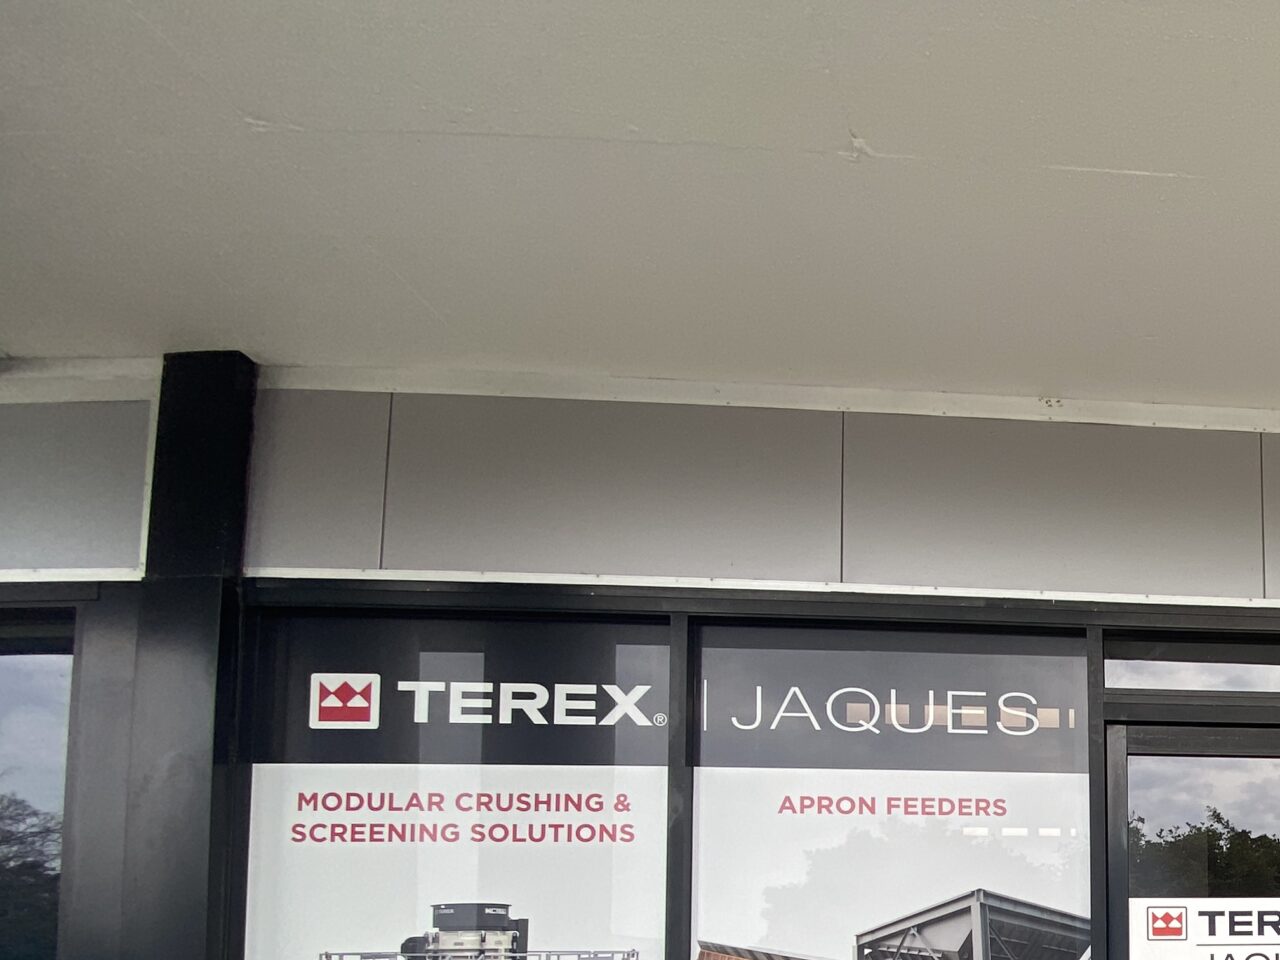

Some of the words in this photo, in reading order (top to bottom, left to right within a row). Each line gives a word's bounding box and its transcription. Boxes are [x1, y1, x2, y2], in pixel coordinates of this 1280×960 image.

[730, 685, 1040, 736] JAQUES
[296, 791, 445, 812] MODULAR
[454, 792, 604, 812] CRUSHING
[613, 792, 632, 812] &
[777, 795, 877, 816] APRON
[886, 797, 1008, 817] FEEDERS
[290, 822, 461, 843] SCREENING
[469, 823, 636, 843] SOLUTIONS
